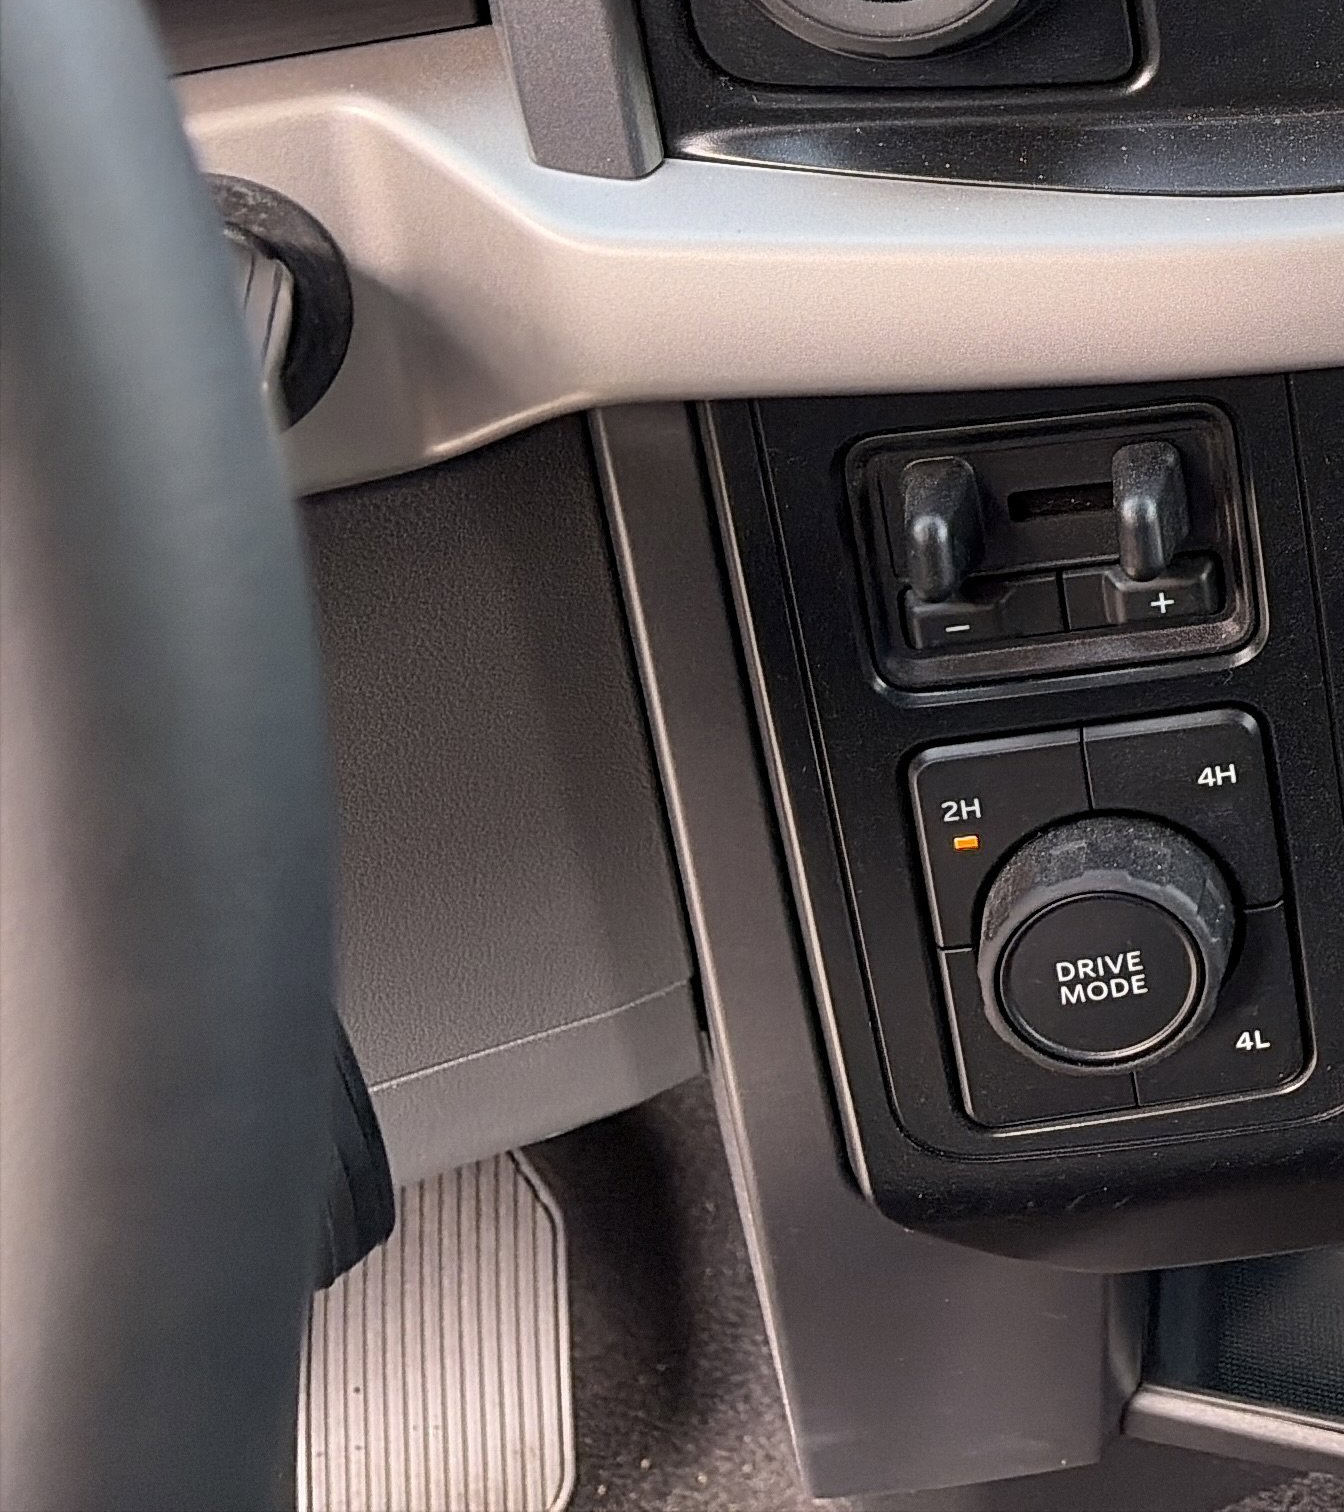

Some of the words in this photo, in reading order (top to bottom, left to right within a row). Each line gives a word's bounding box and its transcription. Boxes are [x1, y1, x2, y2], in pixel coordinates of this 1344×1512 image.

[1196, 762, 1238, 788] 4H
[940, 797, 983, 823] 2H
[1055, 950, 1145, 983] DRIVE
[1059, 973, 1149, 1006] MODE
[1234, 1028, 1271, 1051] 4L
